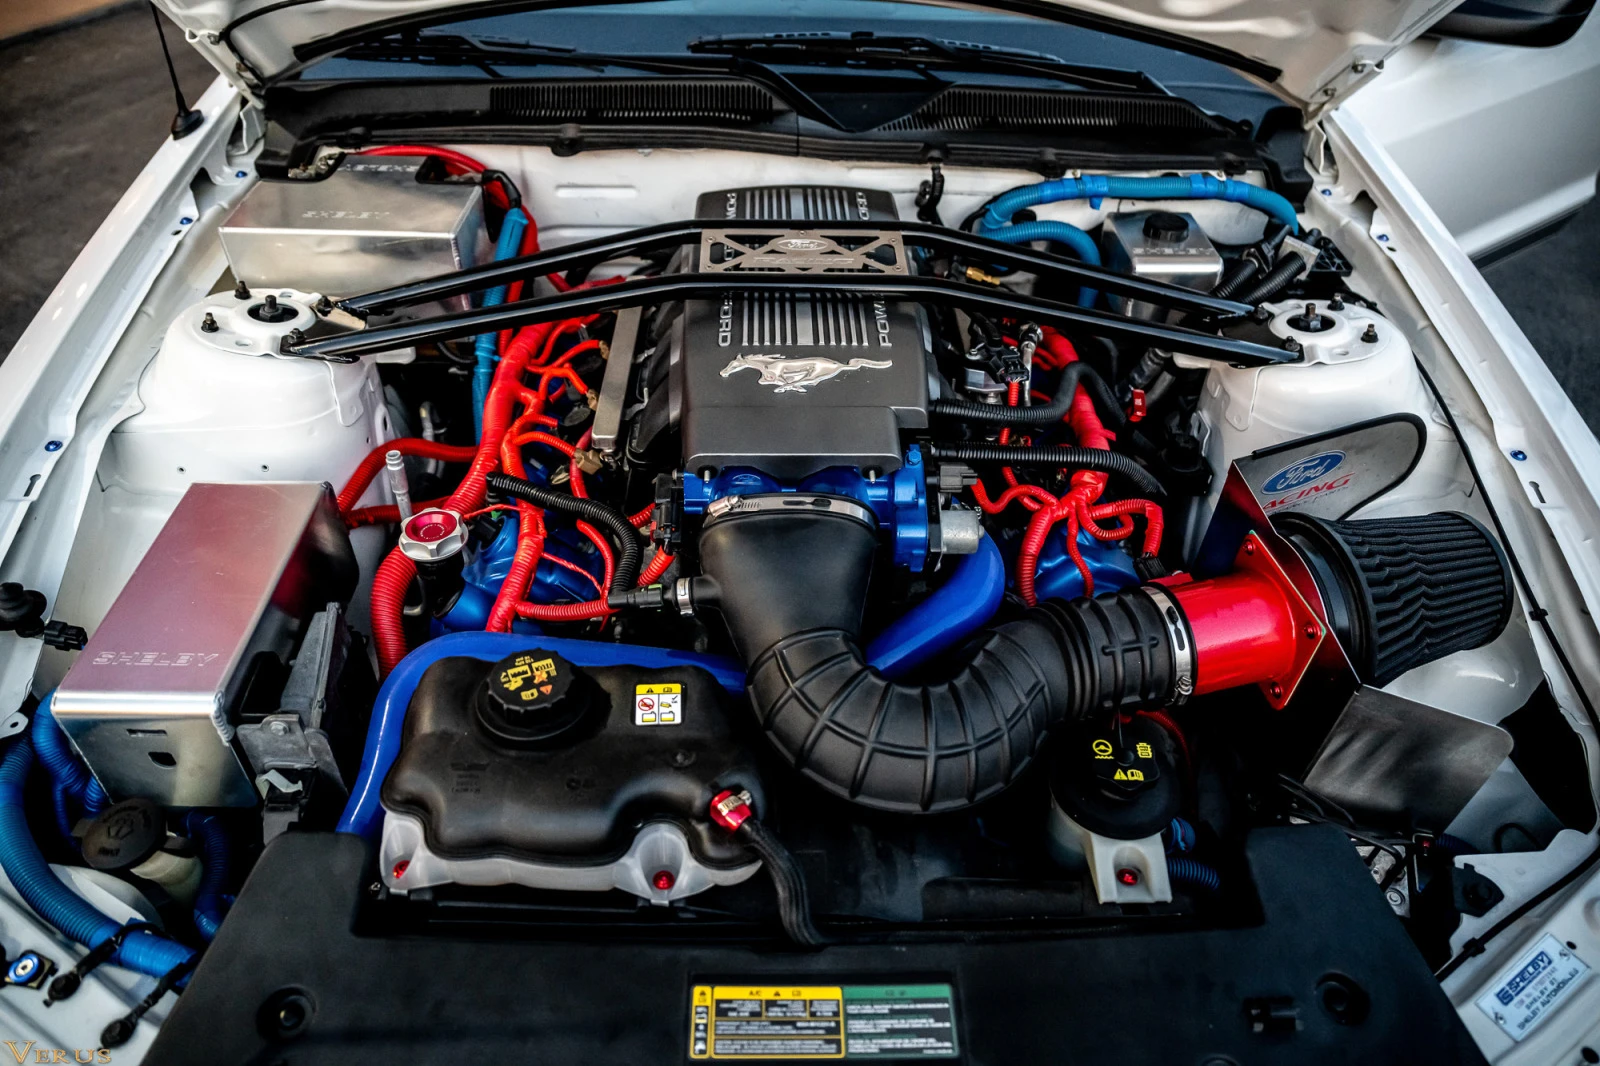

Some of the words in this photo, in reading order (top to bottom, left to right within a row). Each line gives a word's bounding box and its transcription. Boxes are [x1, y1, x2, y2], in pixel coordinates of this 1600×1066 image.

[1276, 459, 1331, 490] Ford
[1263, 472, 1356, 510] ACING
[92, 651, 220, 667] SHELBY
[1508, 955, 1548, 993] SHELBY
[1525, 986, 1549, 1010] SHELBY
[1517, 1006, 1542, 1031] SHELBY
